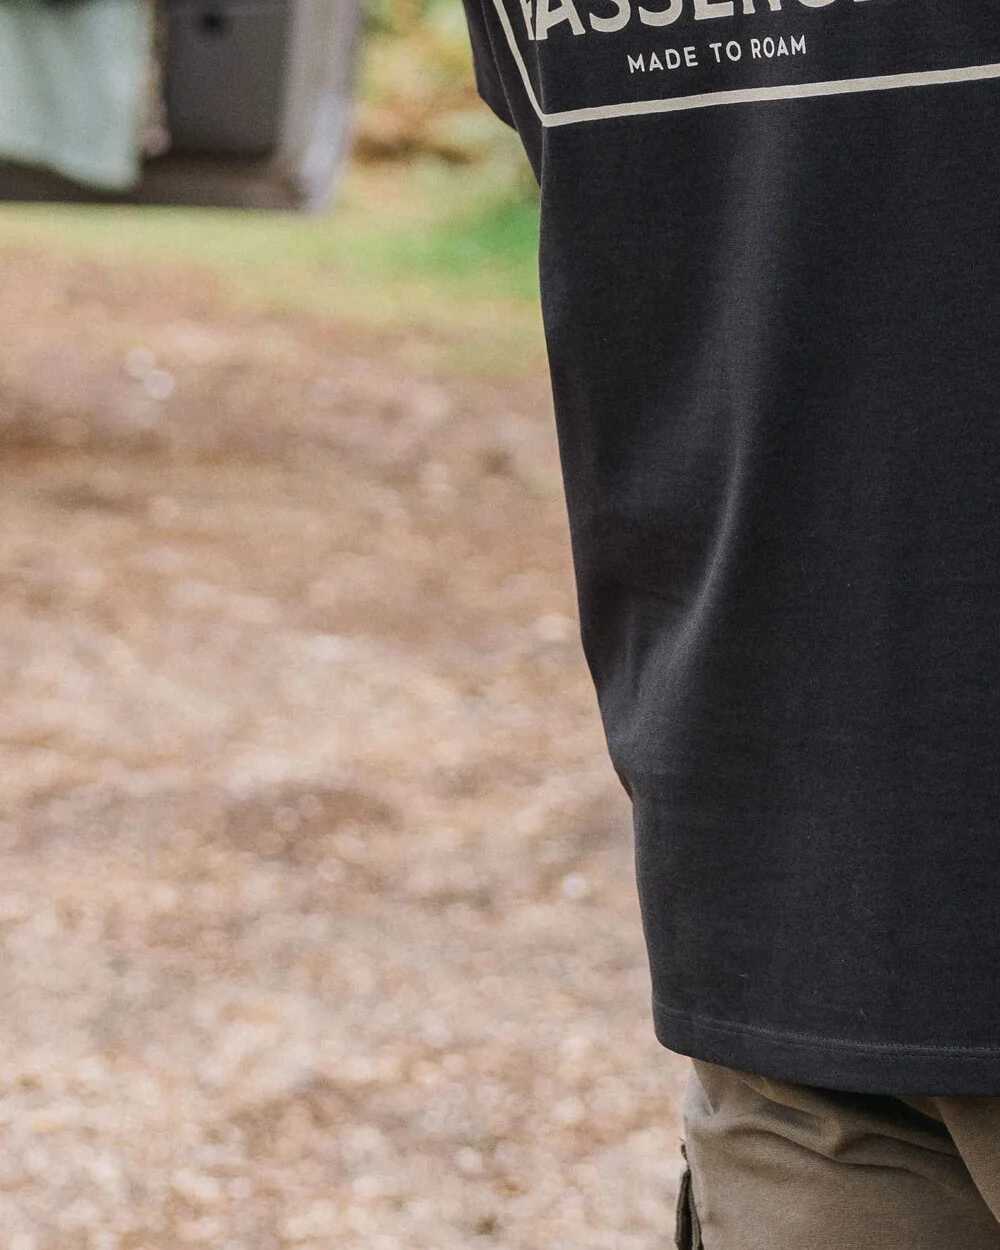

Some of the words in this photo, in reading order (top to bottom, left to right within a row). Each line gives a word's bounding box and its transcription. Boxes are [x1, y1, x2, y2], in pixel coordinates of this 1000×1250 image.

[627, 45, 699, 74] MADE
[708, 40, 742, 63] TO
[750, 34, 807, 60] ROAM
